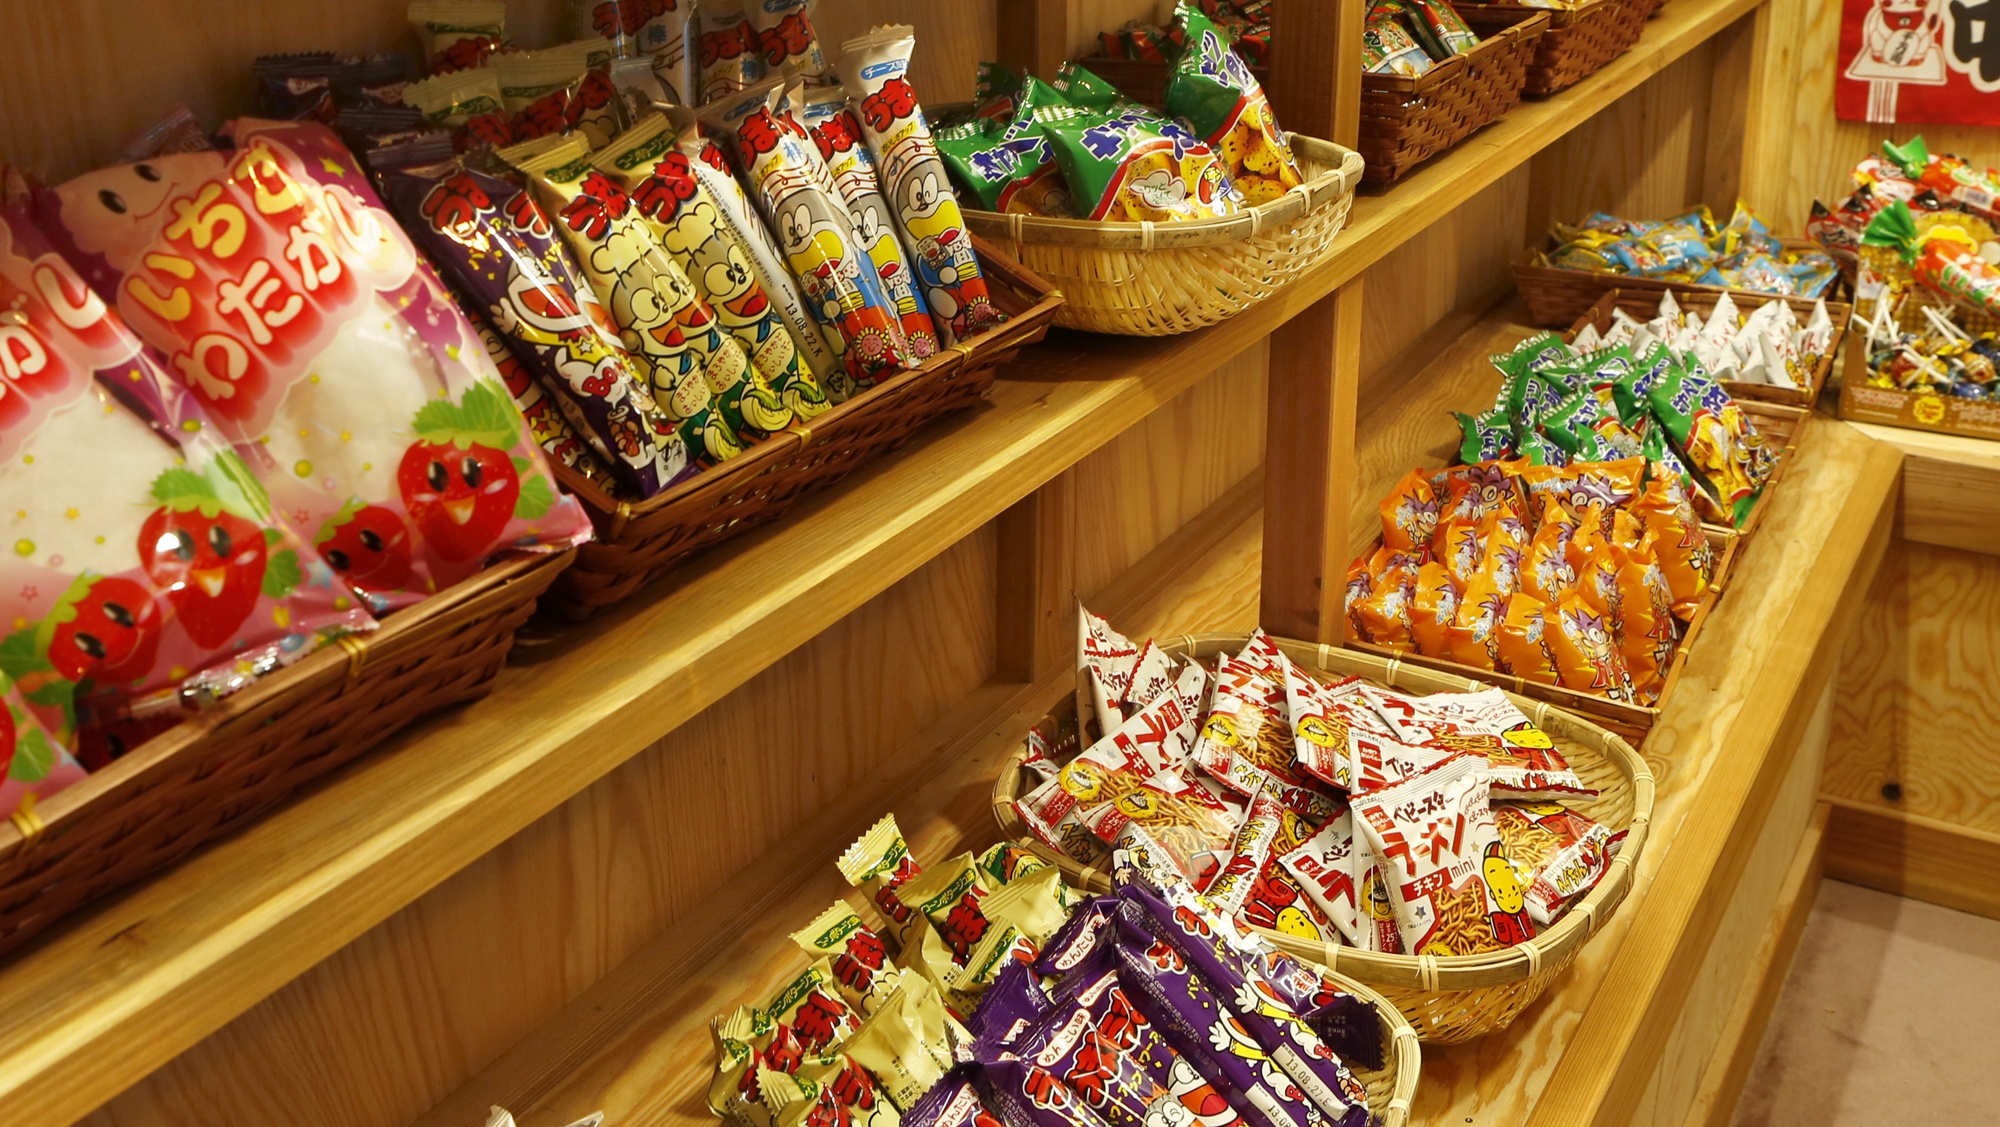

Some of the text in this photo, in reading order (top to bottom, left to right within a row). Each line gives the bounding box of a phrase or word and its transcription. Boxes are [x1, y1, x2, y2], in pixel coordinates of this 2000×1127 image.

[632, 151, 698, 224] うまい
[125, 142, 303, 321] いちご
[173, 190, 381, 399] わたがし
[784, 302, 824, 358] 13.08.22.K
[1121, 742, 1154, 781] チキン
[1181, 771, 1218, 806] チキン
[1393, 791, 1455, 824] ベビースター
[1382, 812, 1465, 878] ラーメン
[1451, 856, 1476, 879] mini
[921, 869, 976, 914] コーンポタージュ味
[1413, 873, 1443, 897] チキン
[770, 969, 822, 1017] コーンポタージュ味
[1285, 1058, 1332, 1107] 13.08.27.E
